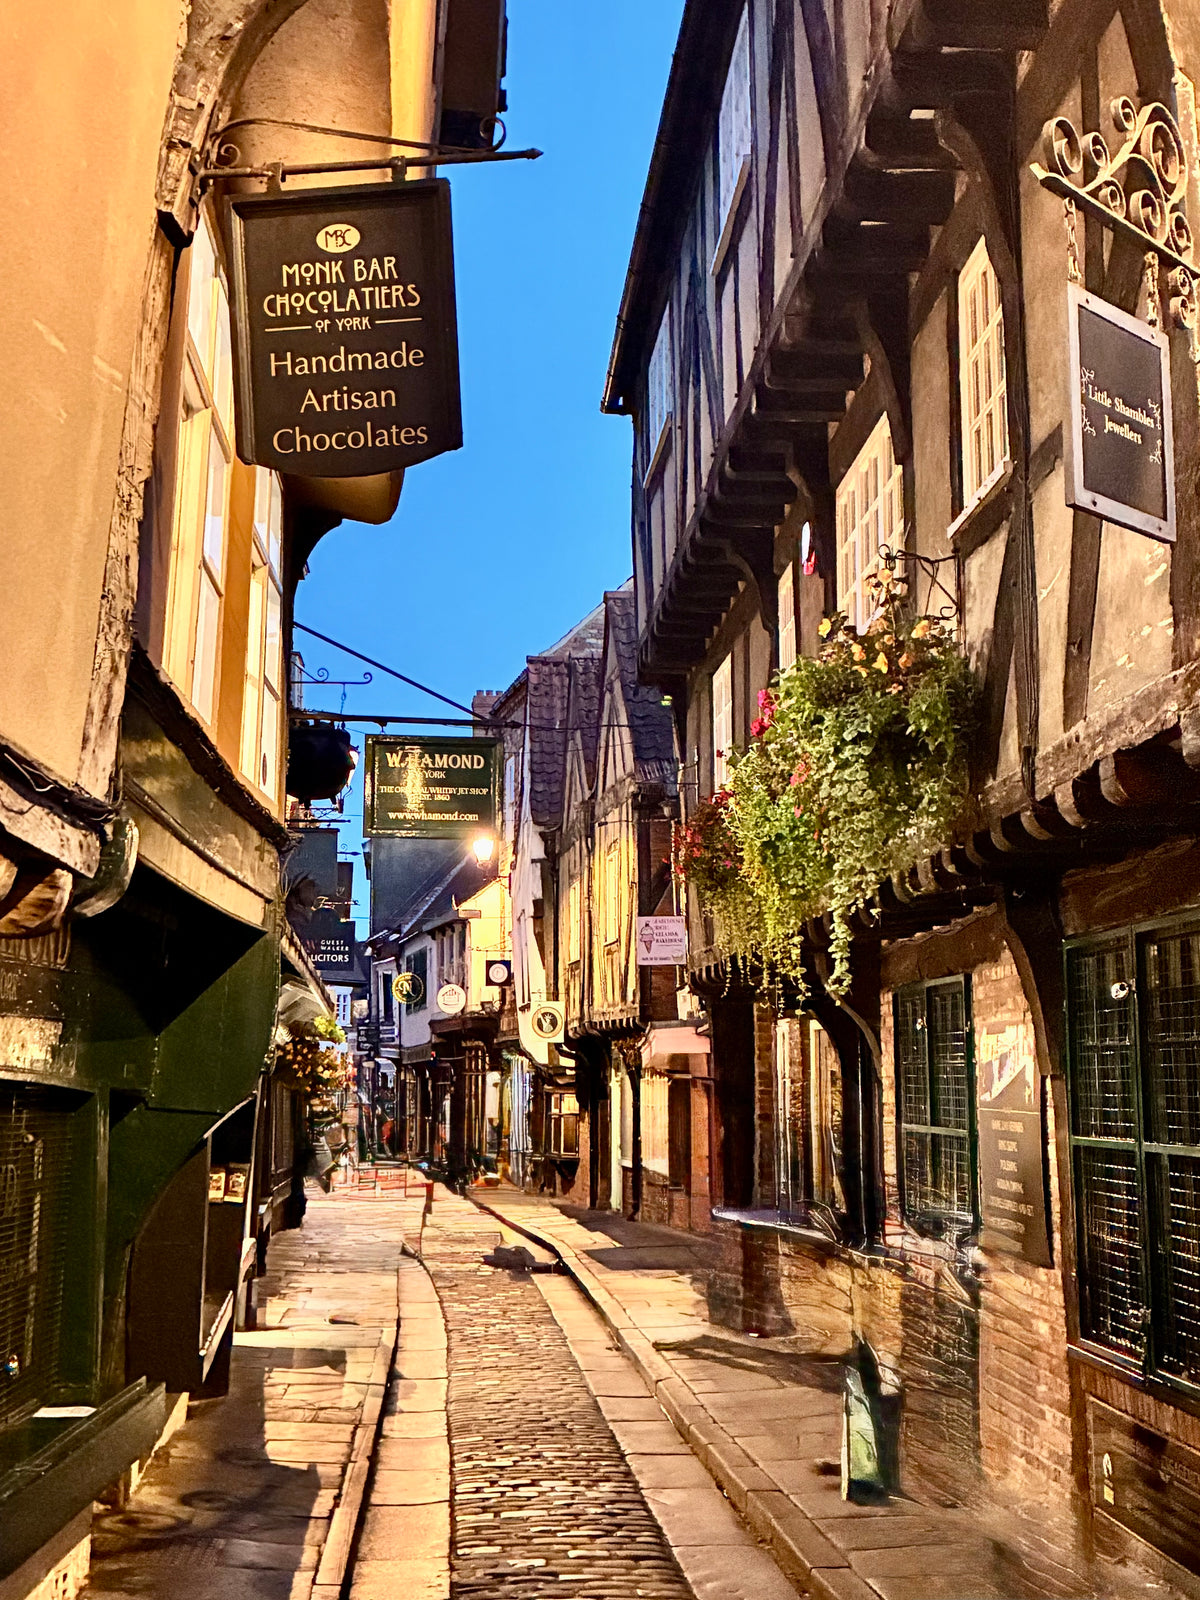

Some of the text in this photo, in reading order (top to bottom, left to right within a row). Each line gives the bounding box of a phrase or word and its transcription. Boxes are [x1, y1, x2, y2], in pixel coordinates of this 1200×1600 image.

[282, 256, 399, 288] MONK BAR
[263, 284, 421, 317] CHOCOLATIERS
[315, 316, 372, 333] OF YORK
[269, 341, 425, 377] Handmade
[300, 386, 397, 414] Artisan
[1088, 384, 1154, 428] Little Shambles
[272, 421, 428, 454] Chocolates
[1103, 414, 1142, 444] Jewellers
[424, 771, 446, 779] YORK
[457, 787, 469, 795] JET
[387, 811, 479, 821] www.whamond.com
